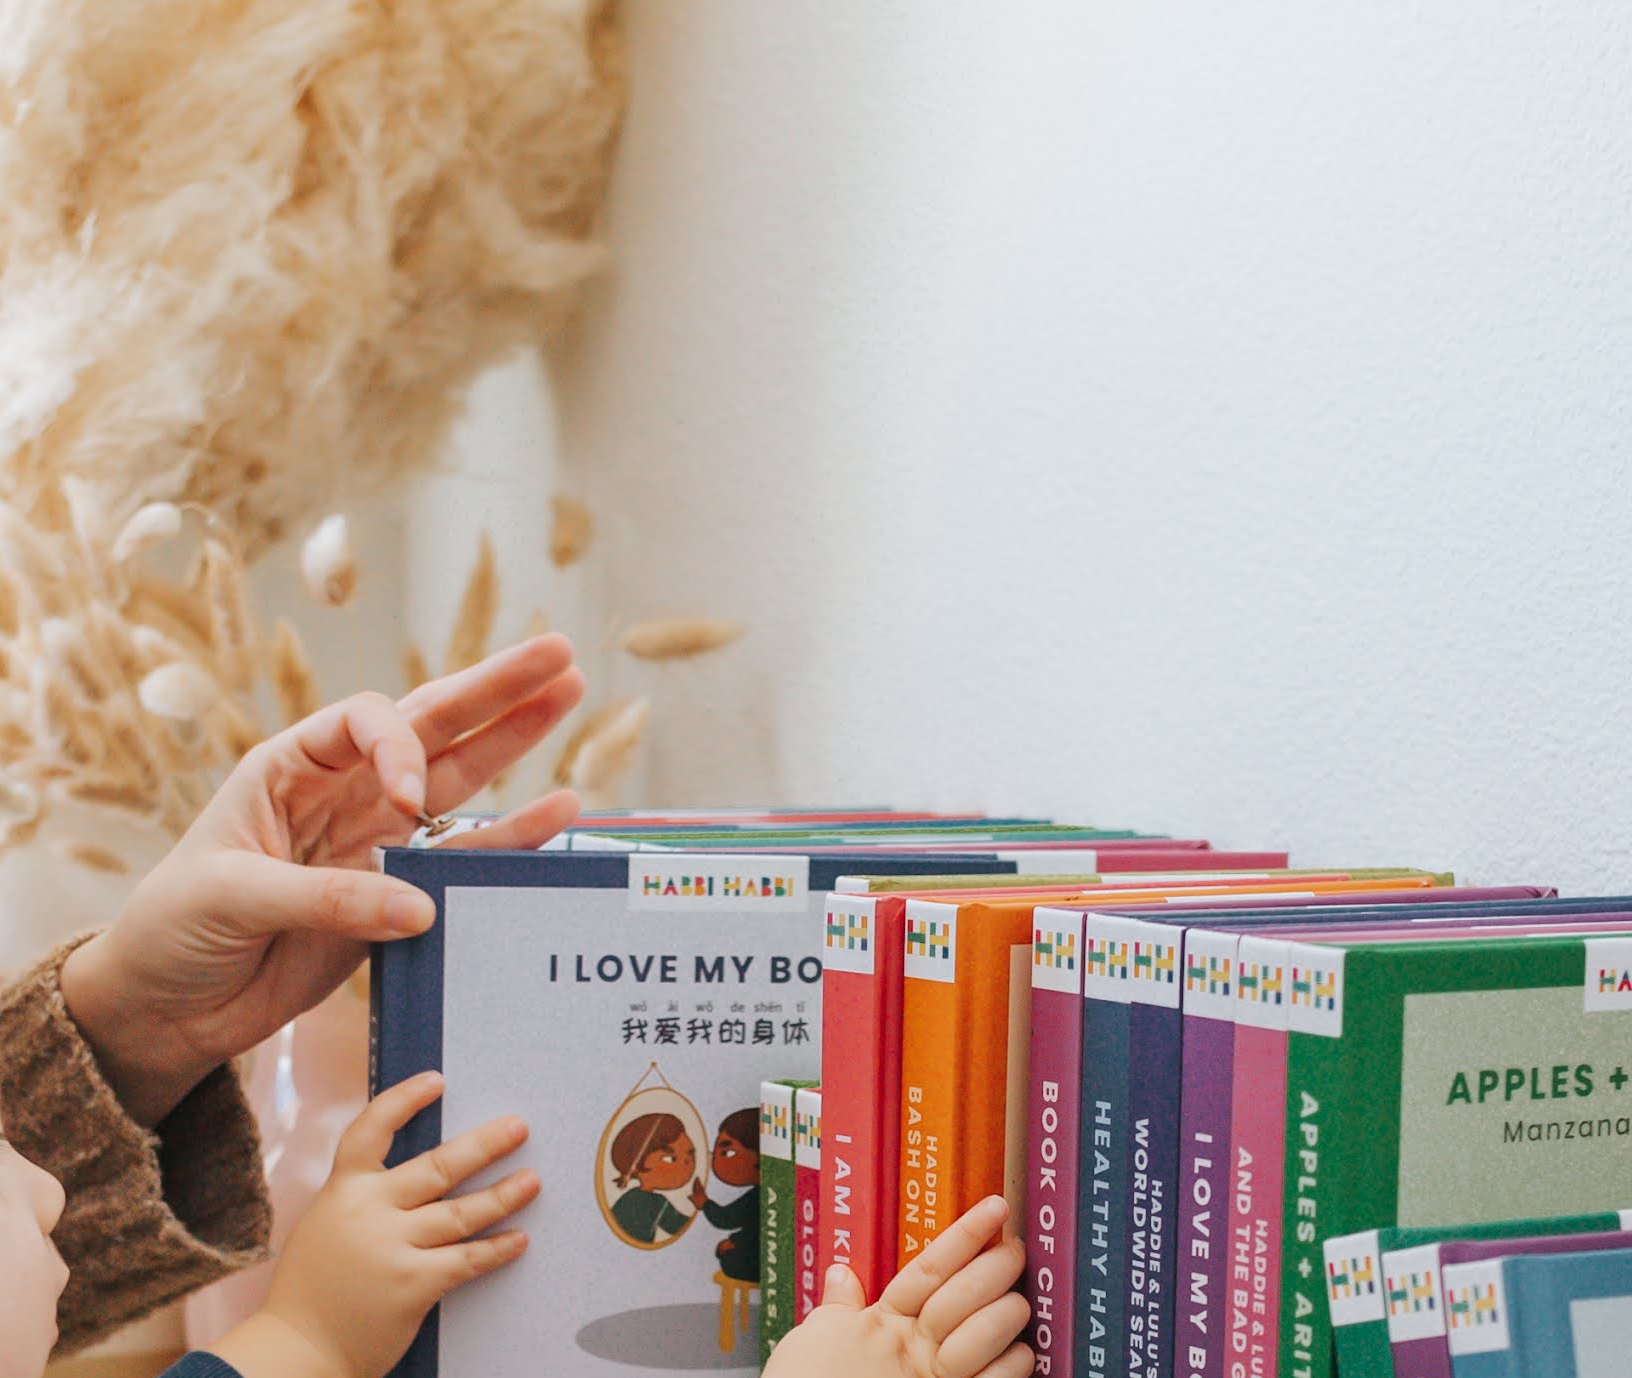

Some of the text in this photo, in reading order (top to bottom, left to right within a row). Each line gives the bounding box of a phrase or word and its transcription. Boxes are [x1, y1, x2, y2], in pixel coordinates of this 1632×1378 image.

[643, 875, 795, 898] HABBI HABBI
[826, 912, 868, 951] HH
[907, 919, 949, 959] HH
[1034, 929, 1075, 970] HH
[549, 954, 824, 985] I LOVE MY BO
[1088, 938, 1127, 980] HH
[1134, 941, 1174, 983] HH
[1187, 954, 1230, 996] HH
[1238, 962, 1282, 1005] HH
[1292, 967, 1335, 1011] HH
[730, 1001, 746, 1013] de
[621, 1017, 810, 1046] 我爱我的身体
[1447, 1062, 1594, 1106] APPLES
[1608, 1066, 1629, 1090] +
[1039, 1080, 1059, 1193] BOOK
[1194, 1132, 1213, 1143] I
[904, 1086, 922, 1253] BASH ON A
[924, 1136, 938, 1231] HADDIE
[1091, 1100, 1112, 1277] HEALTHY
[1236, 1147, 1253, 1216] AND
[1296, 1091, 1319, 1244] APPLES
[833, 1133, 852, 1264] I AM KI
[1130, 1118, 1150, 1306] WORLDWIDE
[1191, 1153, 1212, 1261] LOVE
[1038, 1204, 1056, 1254] OF
[1149, 1179, 1163, 1275] HADDIE
[802, 1199, 815, 1315] GLOBA
[1233, 1223, 1251, 1287] THE
[1251, 1219, 1268, 1316] HADDIE
[1297, 1257, 1313, 1278] +
[1148, 1278, 1160, 1295] &
[1329, 1256, 1374, 1300] HH
[1387, 1271, 1435, 1316] HH
[1189, 1272, 1209, 1334] MY
[1232, 1291, 1249, 1354] BAD
[1448, 1283, 1497, 1329] HH
[1251, 1322, 1264, 1338] &
